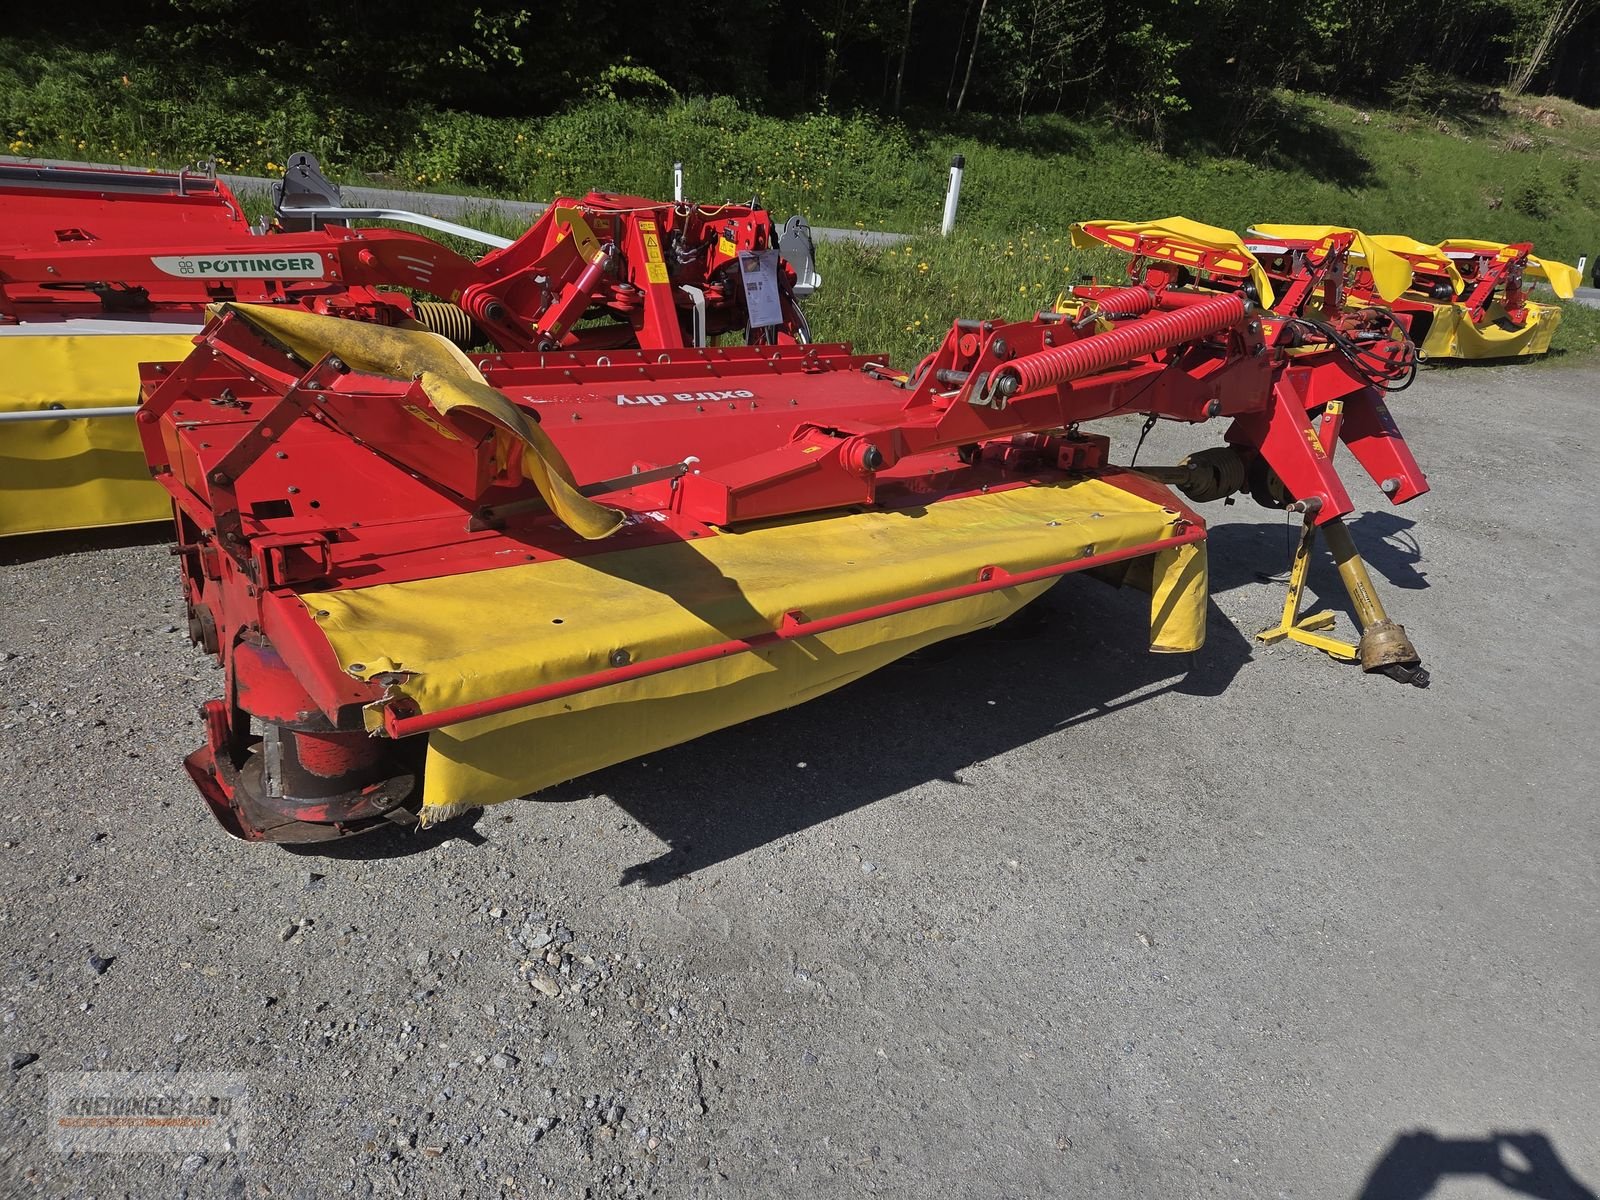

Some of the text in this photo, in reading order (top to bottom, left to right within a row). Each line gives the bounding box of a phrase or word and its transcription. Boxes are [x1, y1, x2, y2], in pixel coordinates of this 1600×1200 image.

[199, 259, 315, 273] PÖTTINGER
[617, 390, 754, 406] extra dry
